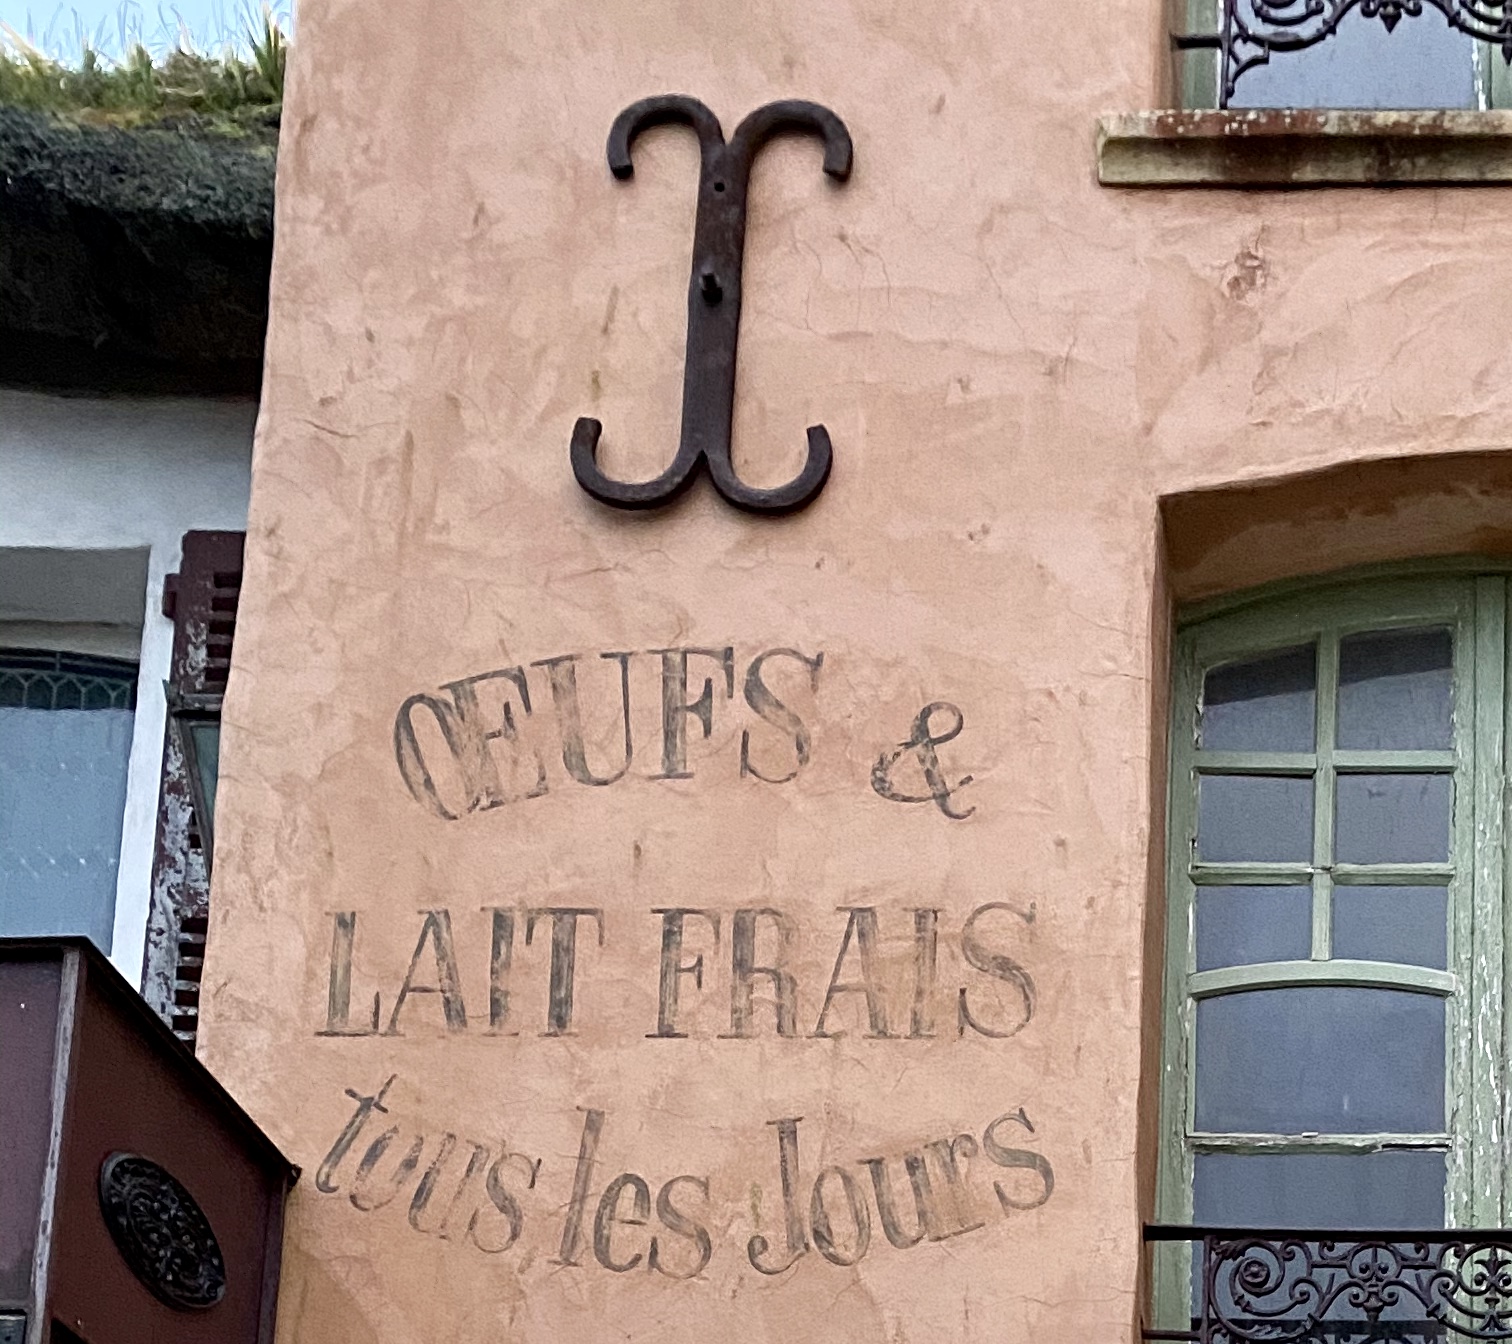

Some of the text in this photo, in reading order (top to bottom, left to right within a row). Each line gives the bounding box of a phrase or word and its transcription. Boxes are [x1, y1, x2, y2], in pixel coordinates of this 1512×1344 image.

[394, 646, 976, 821] ŒUFS &
[314, 900, 1039, 1041] LAIT FRAIS
[314, 1074, 542, 1254] tous
[549, 1105, 713, 1280] les
